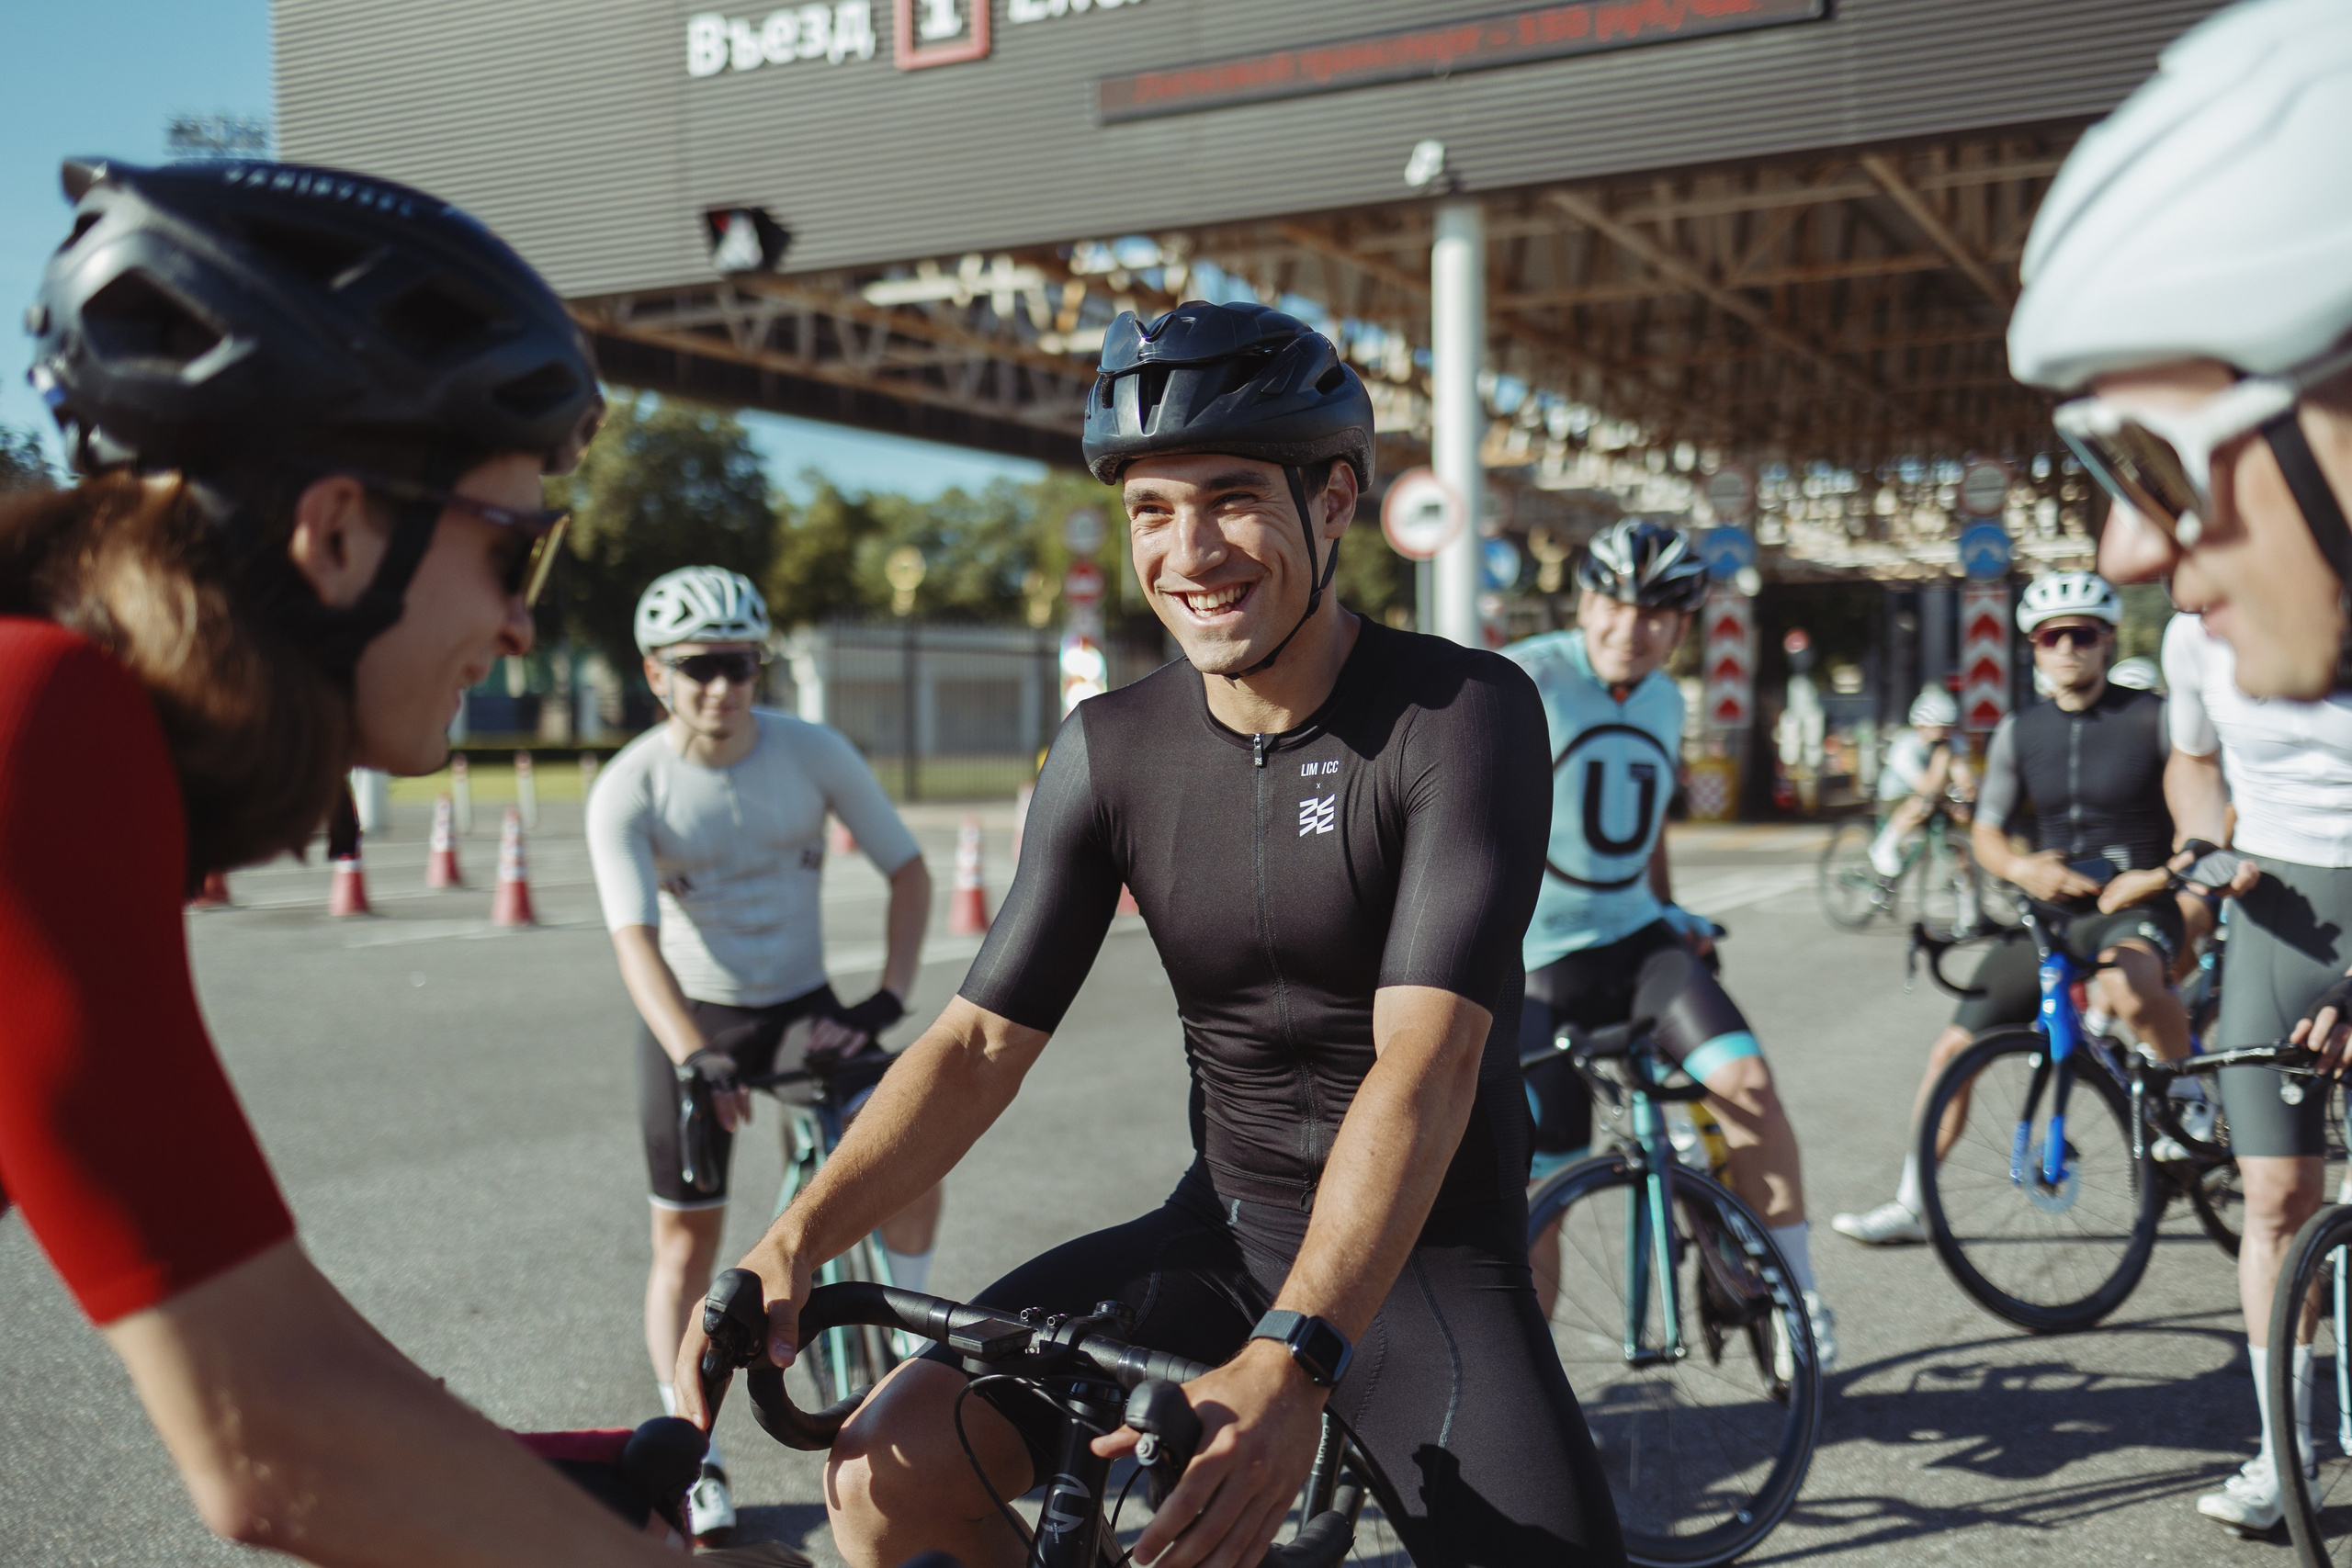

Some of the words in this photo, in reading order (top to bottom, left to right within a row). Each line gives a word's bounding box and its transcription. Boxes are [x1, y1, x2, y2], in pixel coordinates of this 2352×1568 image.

[687, 0, 876, 77] Въезд
[919, 0, 963, 40] 1
[1300, 761, 1318, 777] LIM
